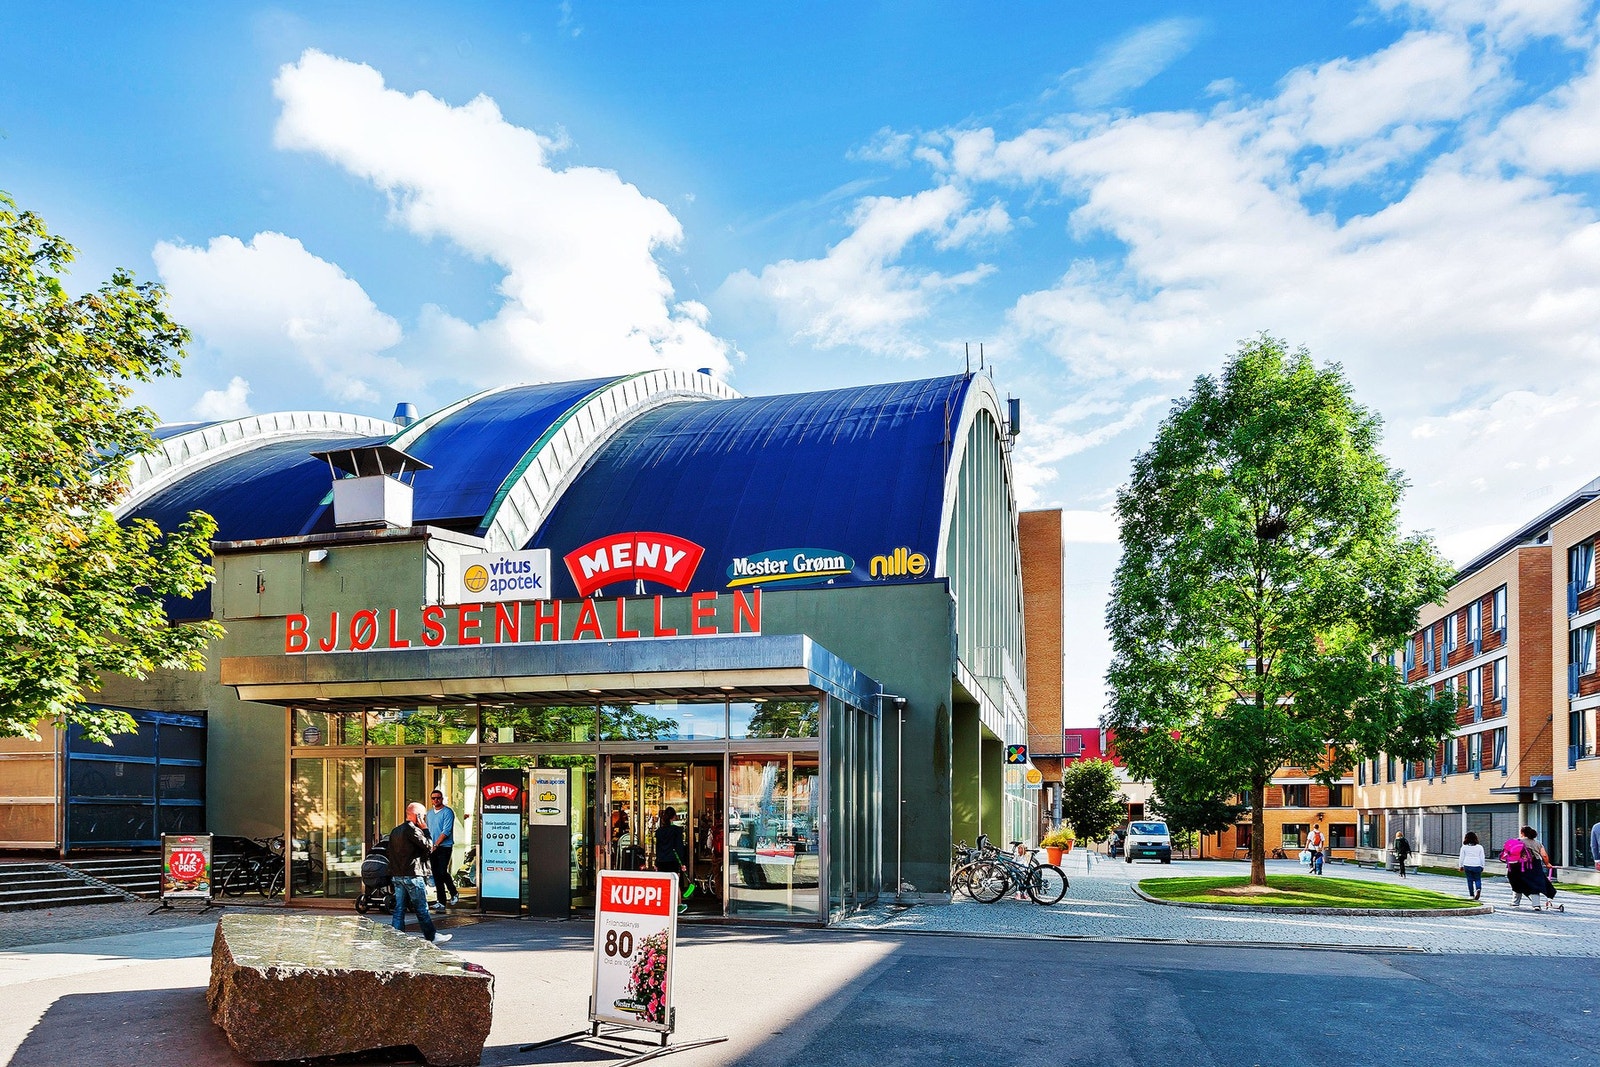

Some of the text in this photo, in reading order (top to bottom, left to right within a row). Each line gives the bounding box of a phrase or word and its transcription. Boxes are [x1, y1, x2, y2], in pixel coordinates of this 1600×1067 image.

[490, 557, 531, 576] vitus
[579, 542, 687, 579] MENY
[733, 554, 846, 576] Mester Grønn
[870, 547, 927, 577] nille
[490, 573, 543, 595] apotek
[285, 588, 762, 654] BJØLSENHALLEN
[487, 786, 515, 796] MENY
[178, 854, 197, 864] 1/2
[178, 864, 196, 872] PRIS
[611, 885, 662, 907] KUPP!
